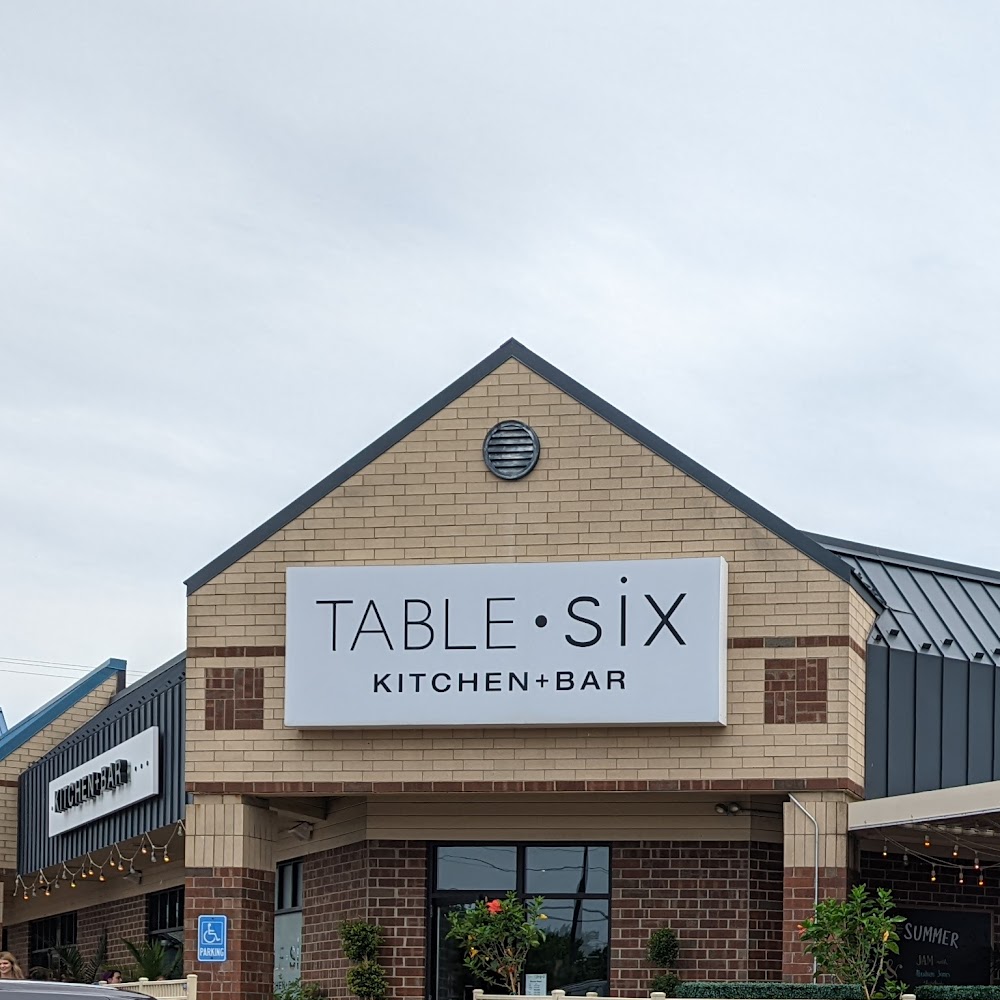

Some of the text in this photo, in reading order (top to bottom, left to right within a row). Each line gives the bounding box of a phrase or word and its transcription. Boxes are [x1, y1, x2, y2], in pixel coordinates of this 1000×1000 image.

[315, 597, 517, 652] TABLE
[373, 670, 626, 694] KITCHEN+BAR
[903, 922, 960, 949] SUMMER
[199, 947, 225, 957] PARKING
